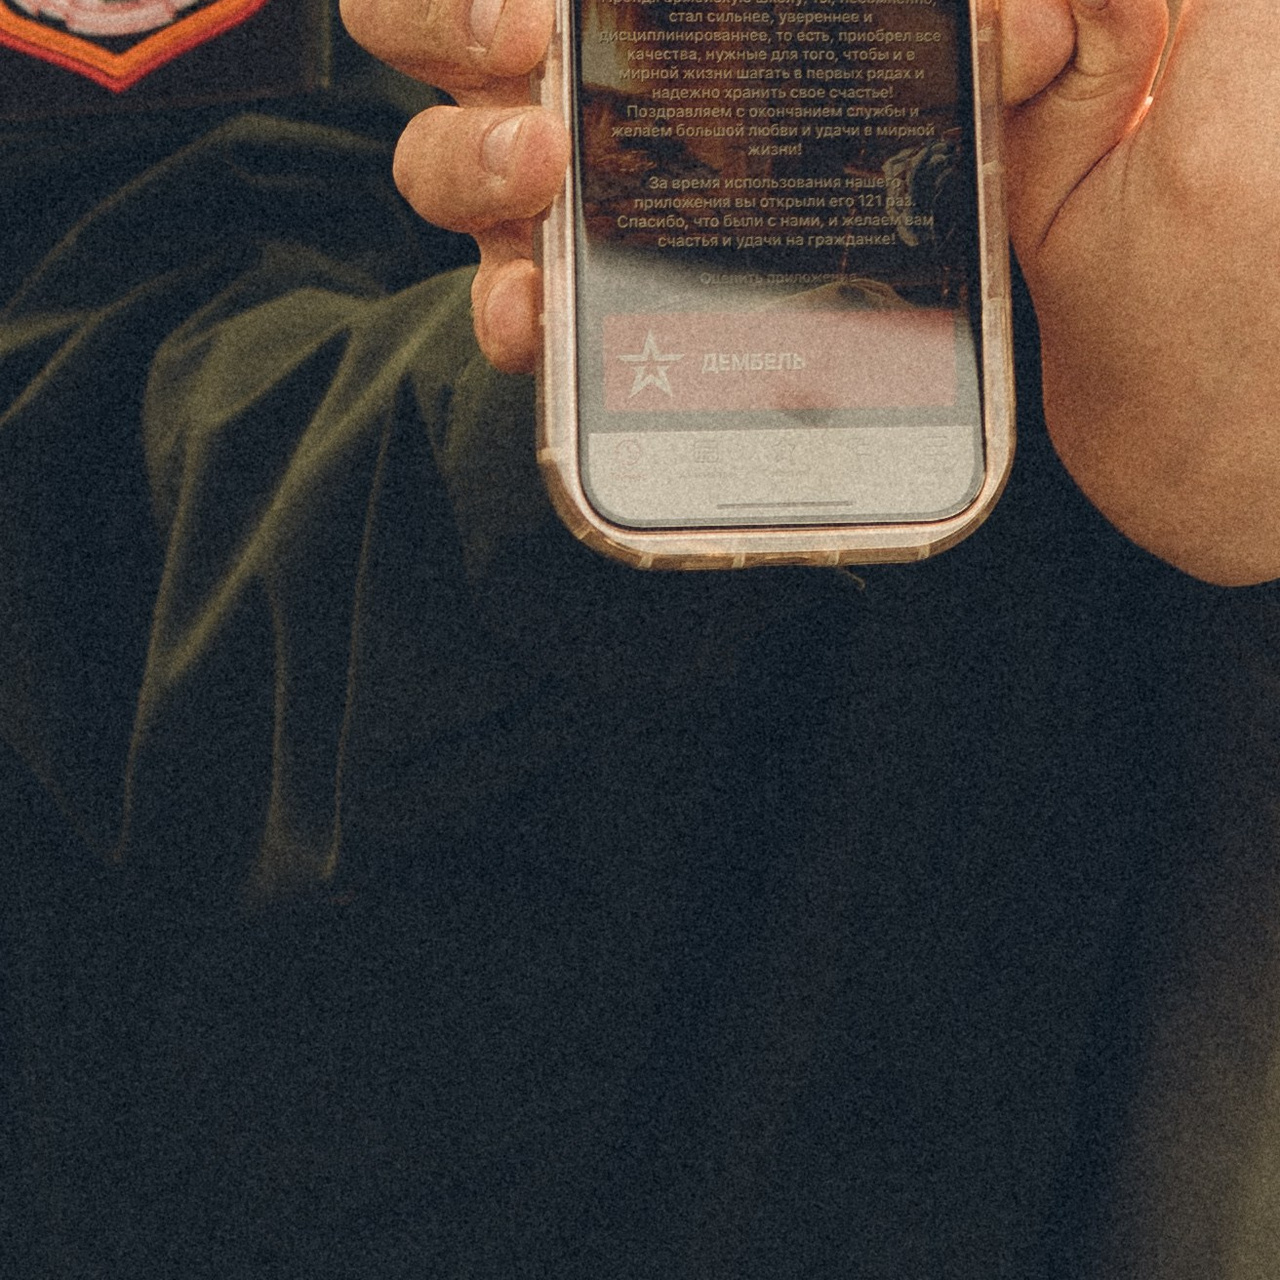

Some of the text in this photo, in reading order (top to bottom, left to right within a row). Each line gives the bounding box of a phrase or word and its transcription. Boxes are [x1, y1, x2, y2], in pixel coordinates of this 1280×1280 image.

[668, 11, 872, 26] стал сильнее, увереннее и
[599, 29, 941, 45] дисциплинированнее, то есть, приобрел все
[627, 48, 915, 63] качества, нужные для того, чтобы и в
[619, 66, 924, 82] мирной жизни шагать в первых рядах и
[652, 87, 893, 101] надежно хранить свое счастье!
[627, 106, 919, 121] Поздравляем с окончанием службы и
[612, 124, 934, 139] желаем большой любви и удачи в мирной
[748, 143, 802, 156] жизни!
[649, 177, 901, 191] За время использования нашего
[634, 196, 916, 211] приложения вы открыли его 121 раз.
[618, 215, 933, 229] Спасибо, что были с нами, и желаем вам
[658, 234, 896, 249] счастья и удачи на гражданке!
[702, 352, 805, 374] ДЕМБЕЛЬ
